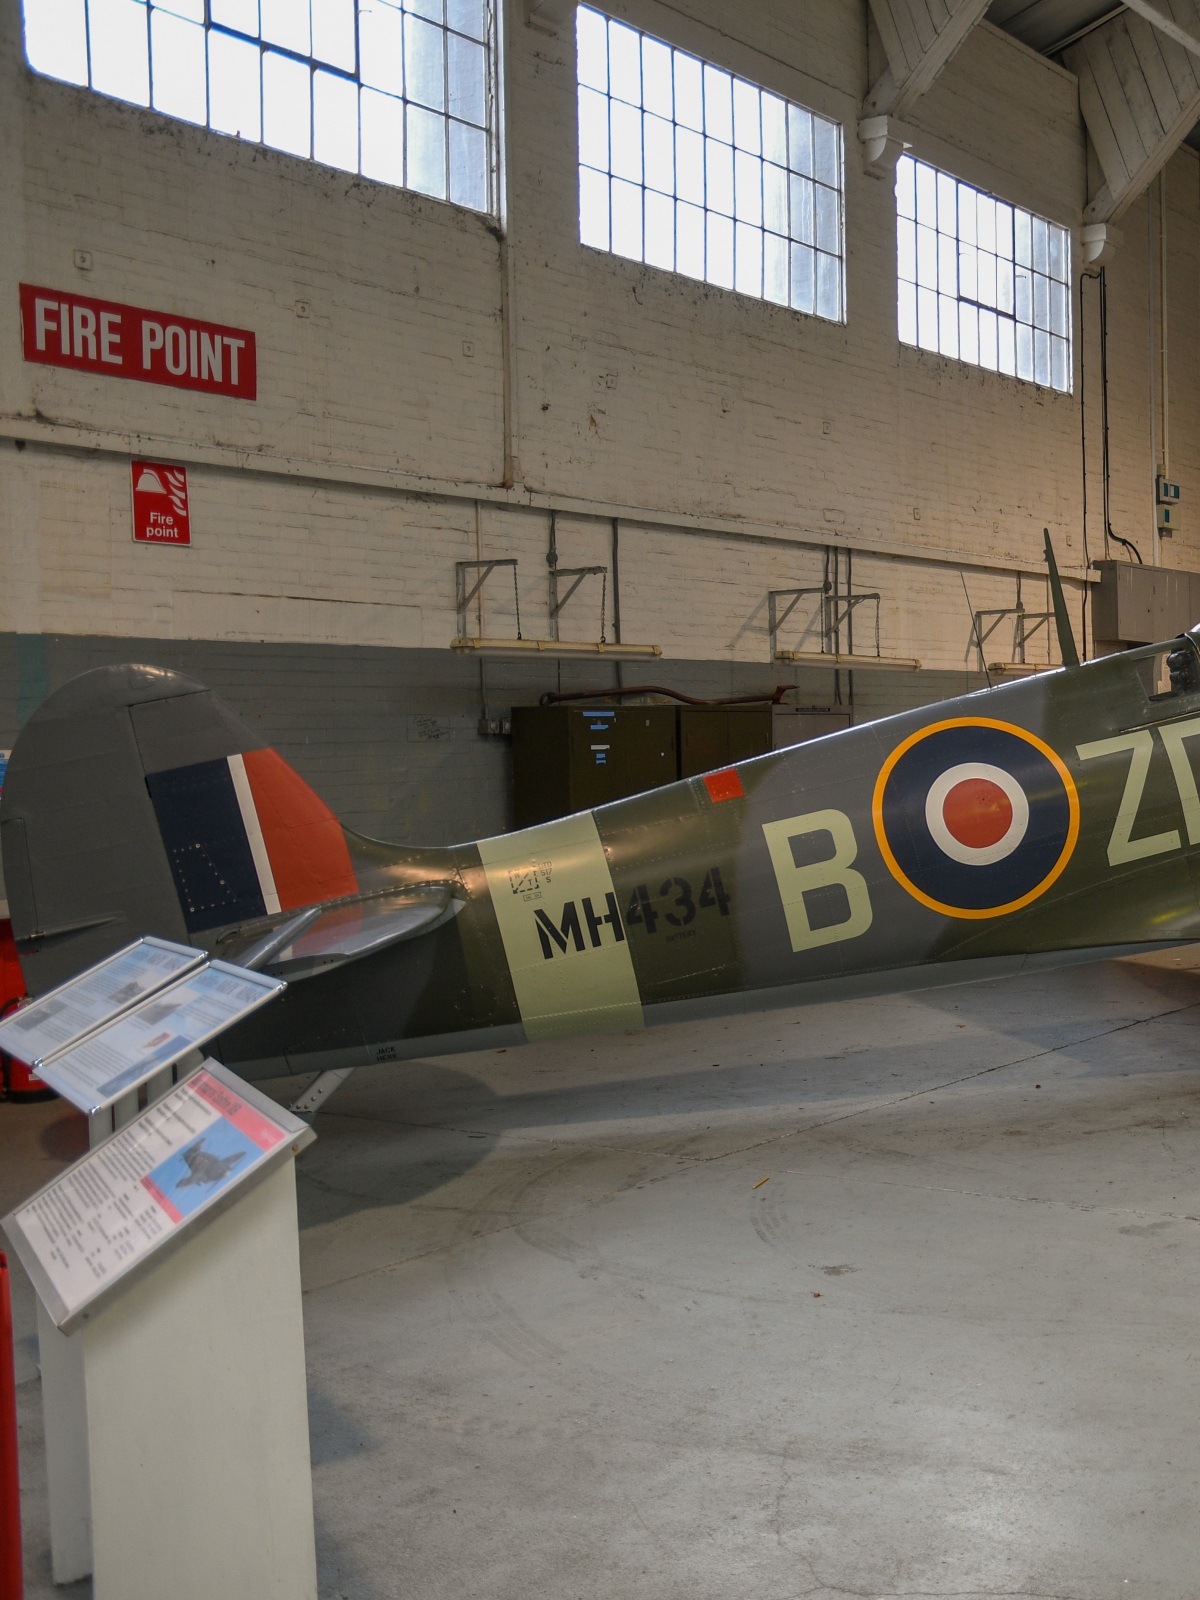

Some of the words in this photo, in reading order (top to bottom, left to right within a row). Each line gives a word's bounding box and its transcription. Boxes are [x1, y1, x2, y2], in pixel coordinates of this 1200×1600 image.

[34, 298, 123, 365] FIRE
[141, 319, 245, 386] POINT
[150, 512, 174, 526] Fire
[146, 525, 179, 539] point
[540, 868, 552, 877] 517
[762, 808, 873, 952] B
[376, 1046, 396, 1055] JACK
